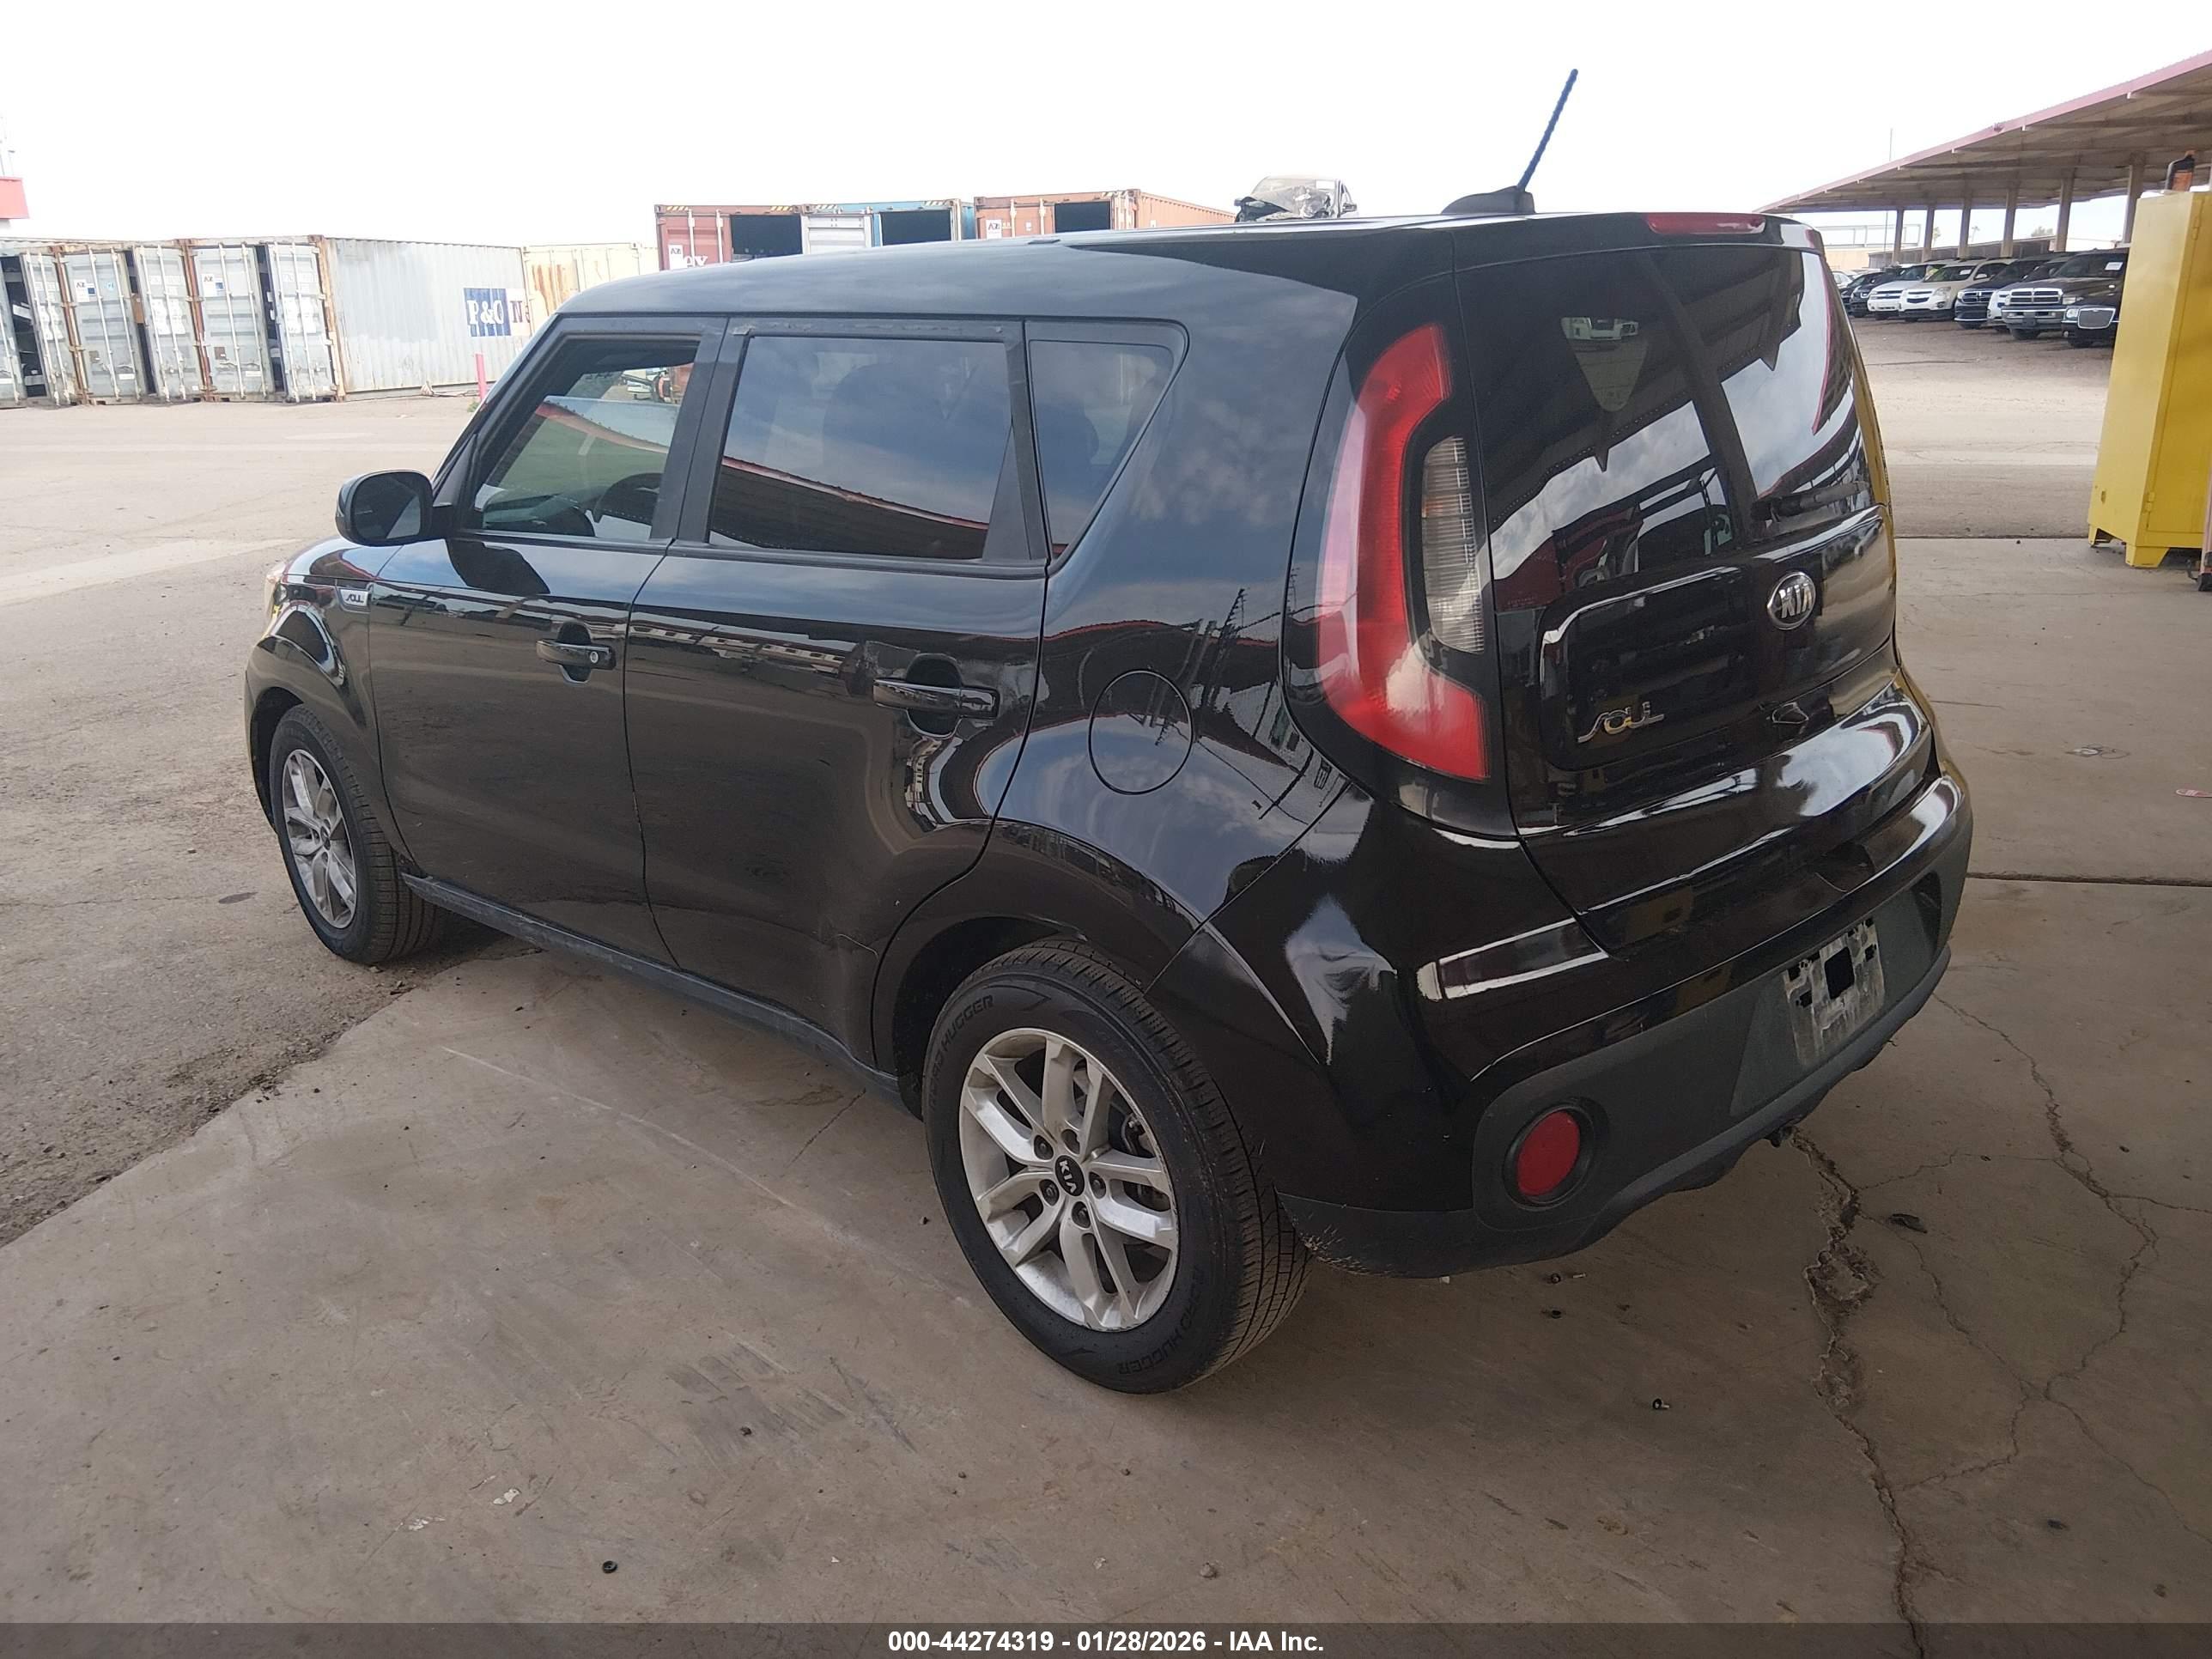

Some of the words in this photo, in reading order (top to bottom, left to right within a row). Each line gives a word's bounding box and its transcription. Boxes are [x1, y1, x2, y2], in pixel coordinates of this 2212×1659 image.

[466, 299, 505, 325] P&O
[1778, 583, 1813, 619] KIA
[1577, 701, 1665, 744] SOUL
[940, 994, 994, 1052] HUGGER
[1059, 1159, 1078, 1194] KIA
